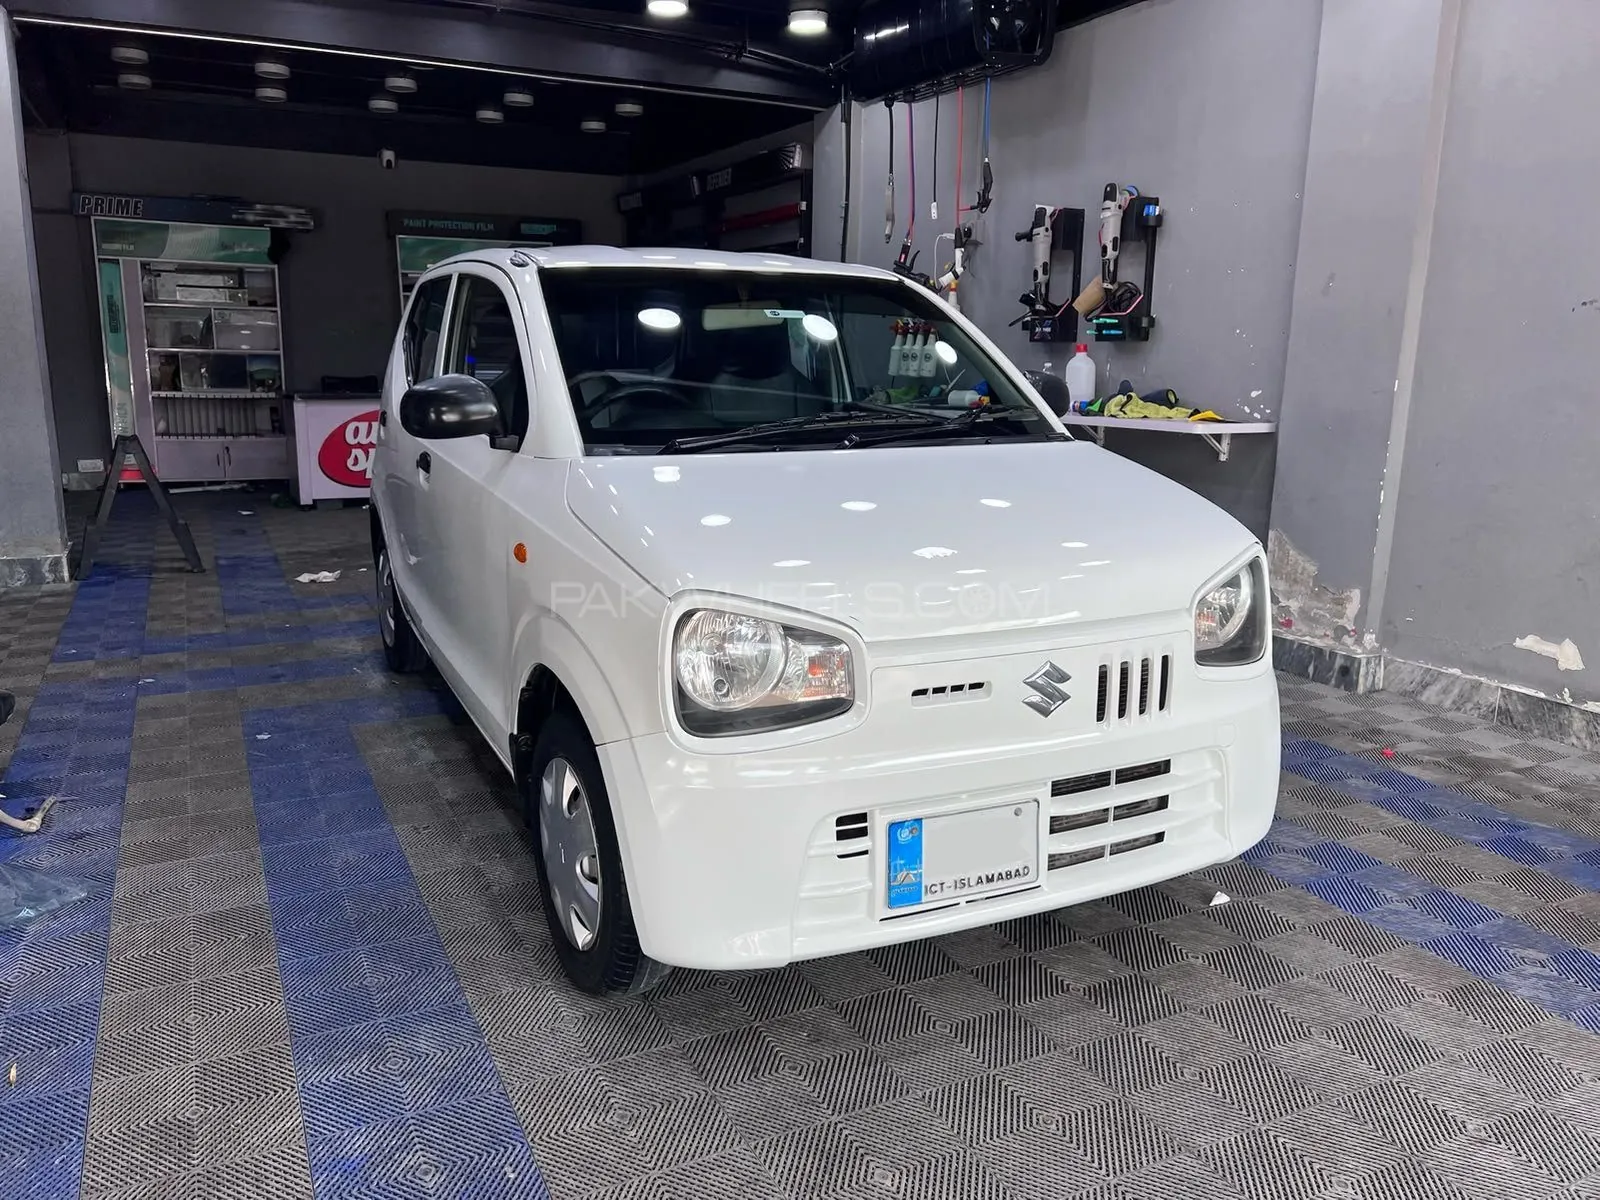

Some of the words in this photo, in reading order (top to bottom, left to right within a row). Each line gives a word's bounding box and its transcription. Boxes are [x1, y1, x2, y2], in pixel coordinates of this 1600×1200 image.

[79, 194, 144, 217] PRIME
[403, 218, 427, 228] PAINT
[428, 219, 475, 231] PROTECTION
[476, 222, 495, 232] FILM
[925, 865, 1031, 895] ICT-ISLAMABAD
